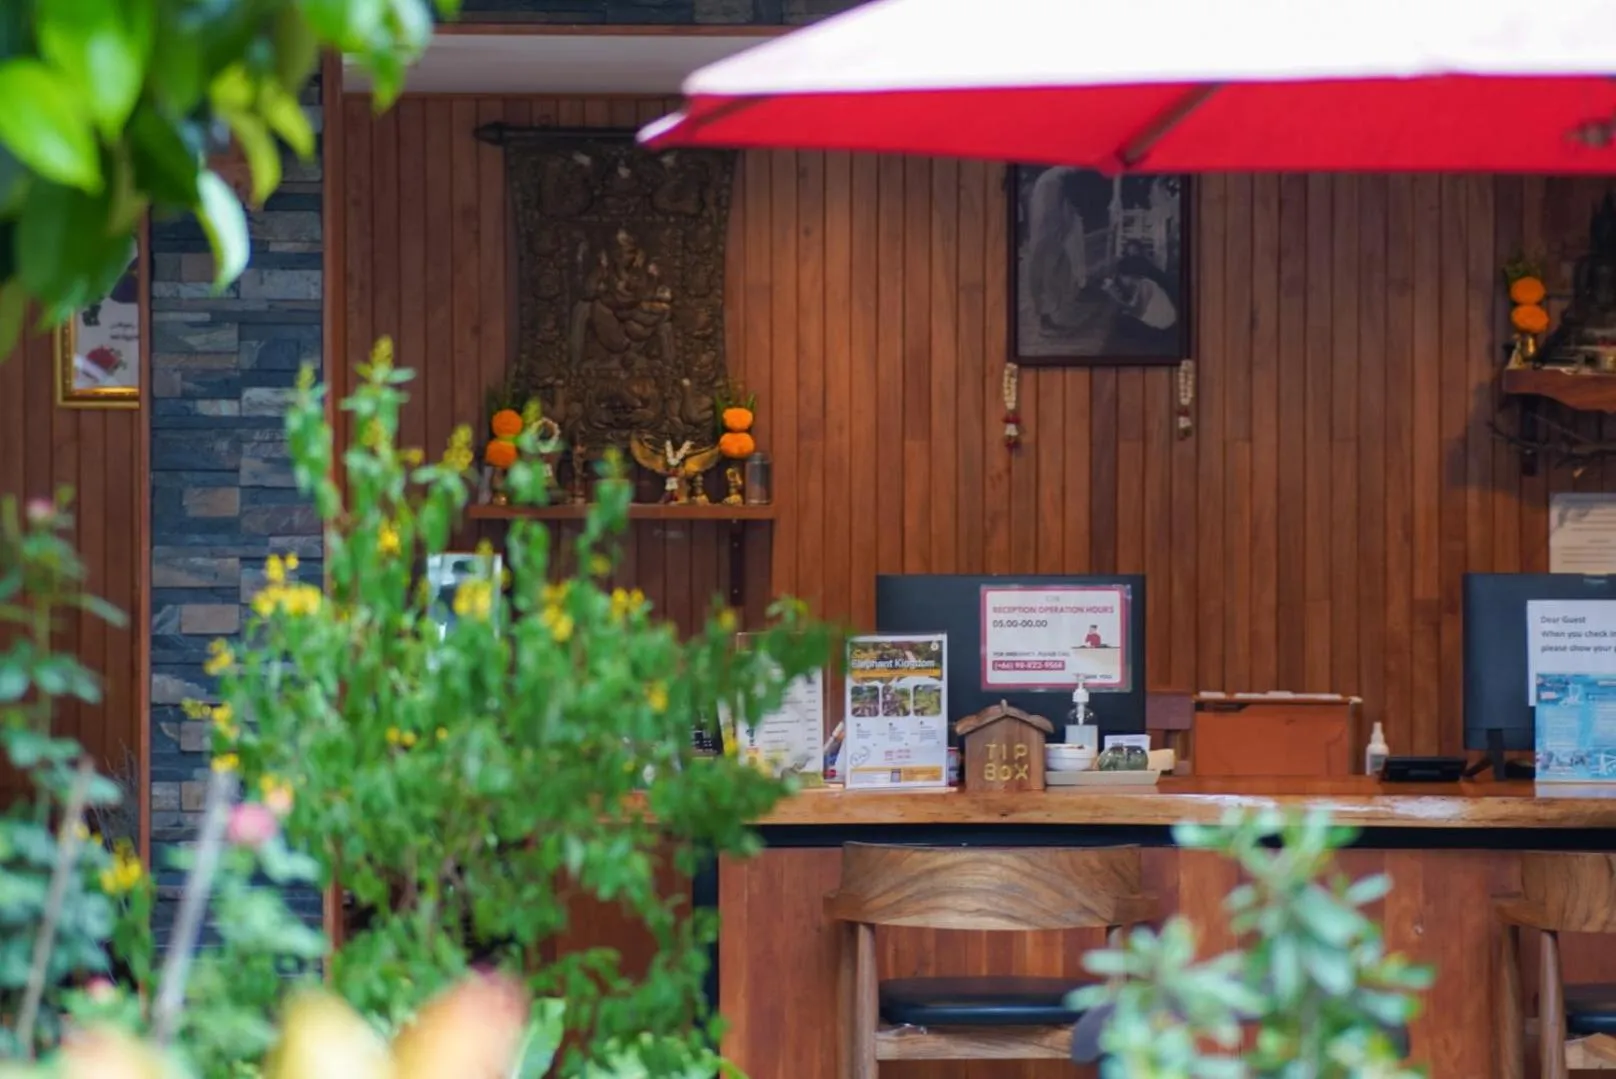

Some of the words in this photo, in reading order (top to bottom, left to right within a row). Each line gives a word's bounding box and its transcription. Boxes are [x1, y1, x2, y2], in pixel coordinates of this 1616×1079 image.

[992, 605, 1036, 614] RECEPTION
[1038, 605, 1085, 614] OPERATION
[1086, 605, 1115, 614] HOURS
[992, 619, 1048, 628] 05.00-00.00
[1540, 615, 1560, 624] Dear
[1561, 615, 1586, 624] Guest
[1584, 629, 1608, 638] check
[1541, 645, 1566, 653] please
[1569, 644, 1592, 652] show
[1593, 645, 1612, 653] your
[851, 659, 893, 670] Elephant
[895, 658, 935, 670] Kingdom
[984, 743, 1028, 760] TIP
[984, 762, 1029, 781] BOX
